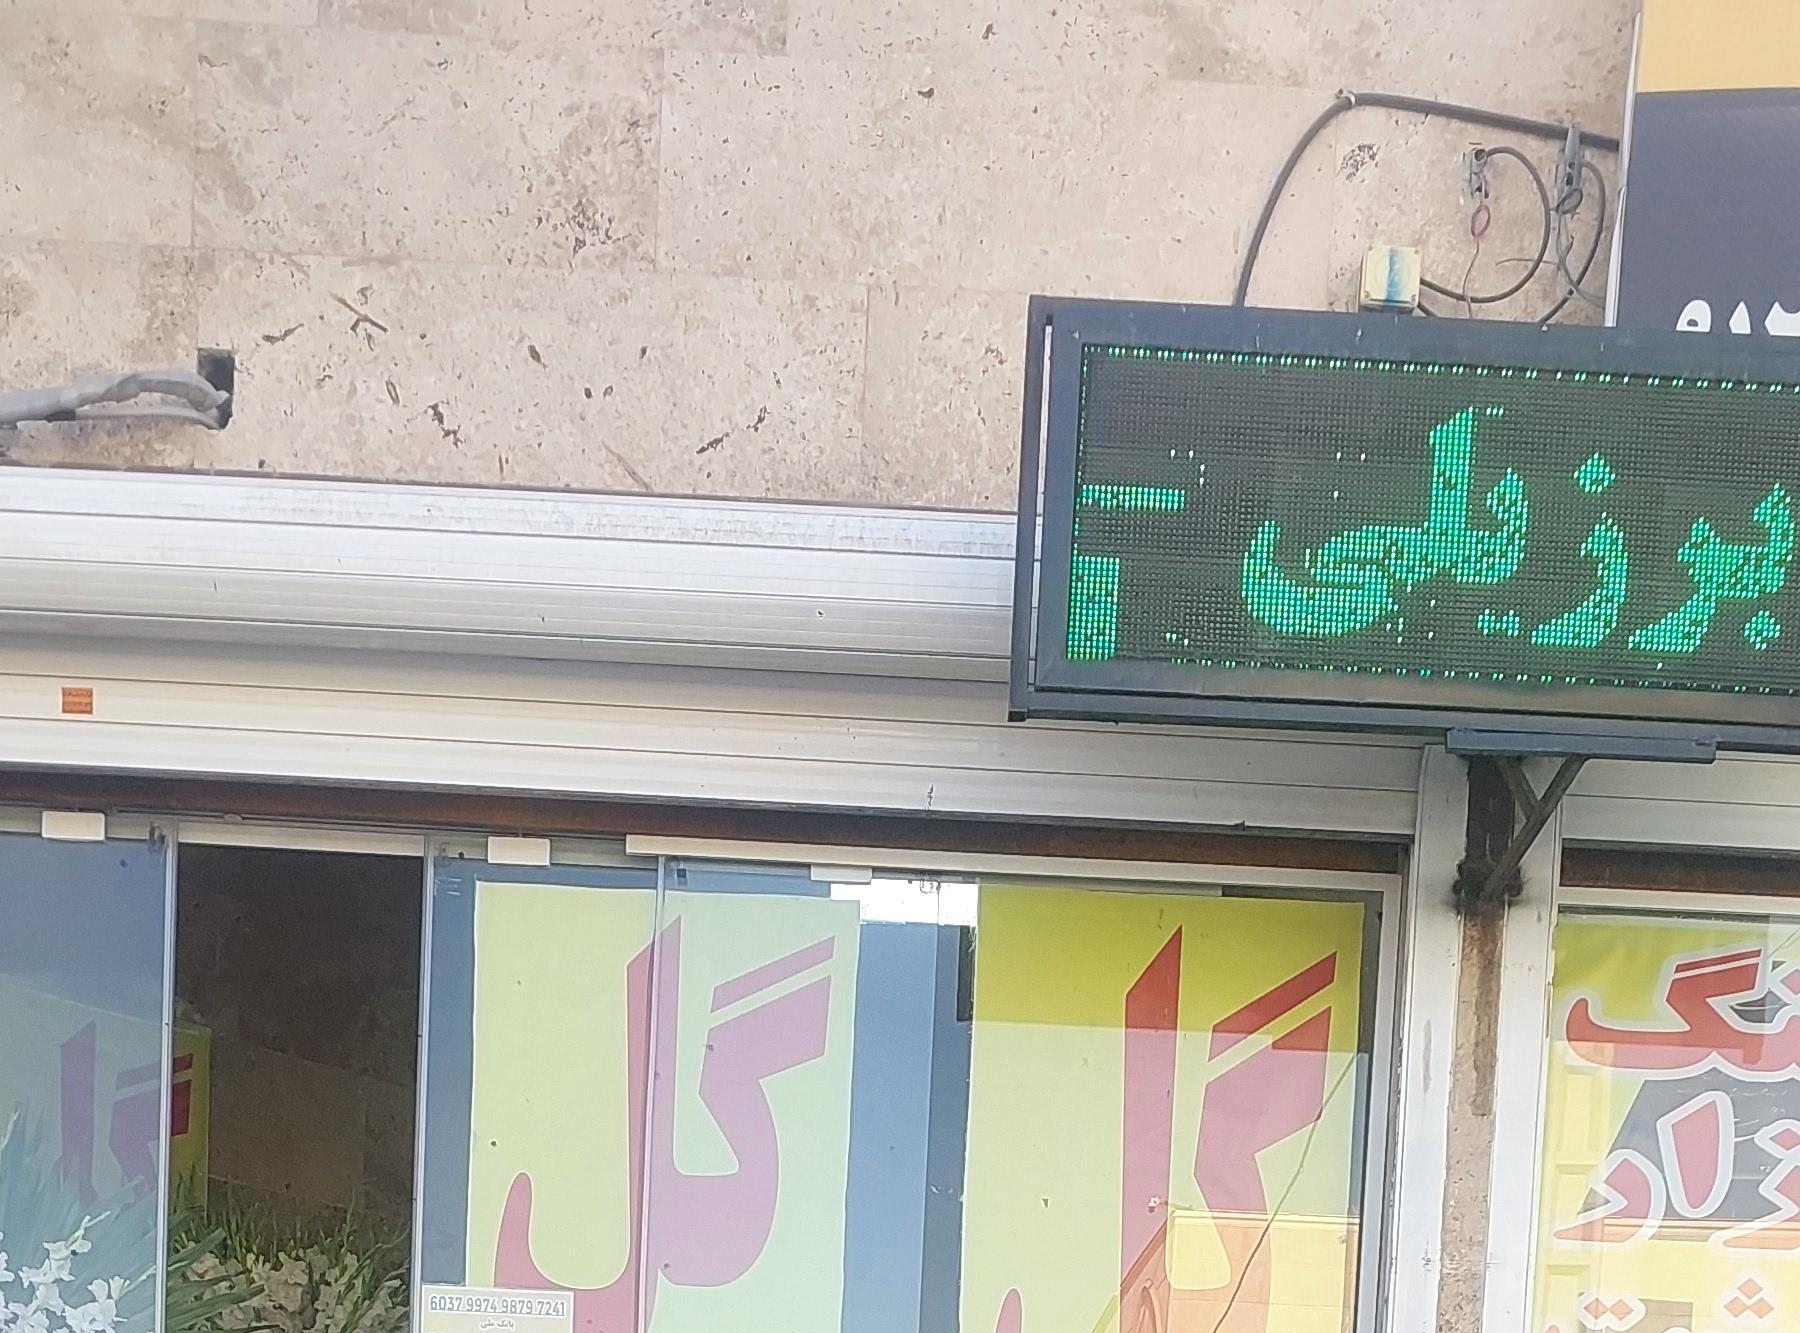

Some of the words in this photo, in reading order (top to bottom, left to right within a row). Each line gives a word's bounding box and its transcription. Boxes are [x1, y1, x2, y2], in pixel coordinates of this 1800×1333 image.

[1241, 405, 1796, 652] برزیلی
[430, 1295, 462, 1311] 6037
[466, 1297, 496, 1313] 9974
[501, 1299, 533, 1315] 9879
[537, 1301, 566, 1316] 7241
